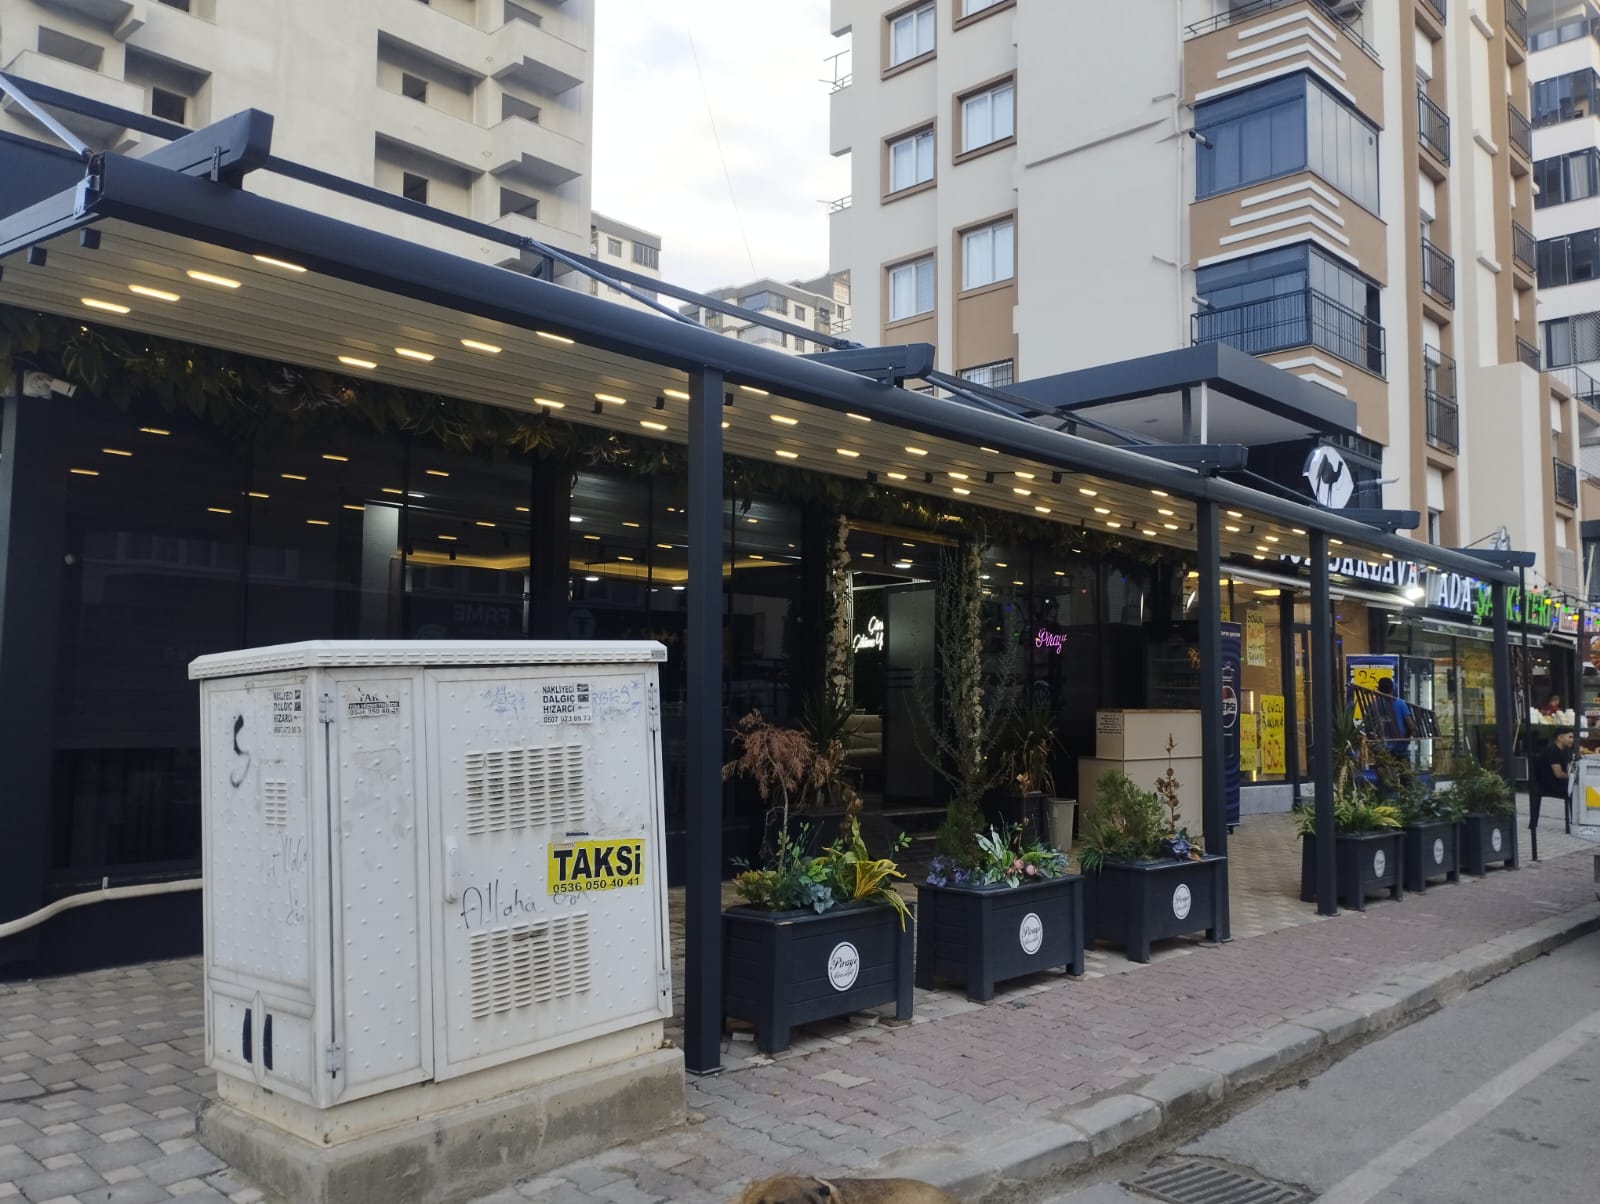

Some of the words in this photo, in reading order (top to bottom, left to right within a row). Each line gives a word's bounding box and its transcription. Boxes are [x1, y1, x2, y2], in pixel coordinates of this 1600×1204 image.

[1438, 572, 1472, 612] ADA
[1223, 702, 1236, 712] EPSI
[553, 881, 582, 894] 0536
[586, 879, 607, 890] 050
[610, 878, 624, 888] 40
[627, 877, 640, 886] 41
